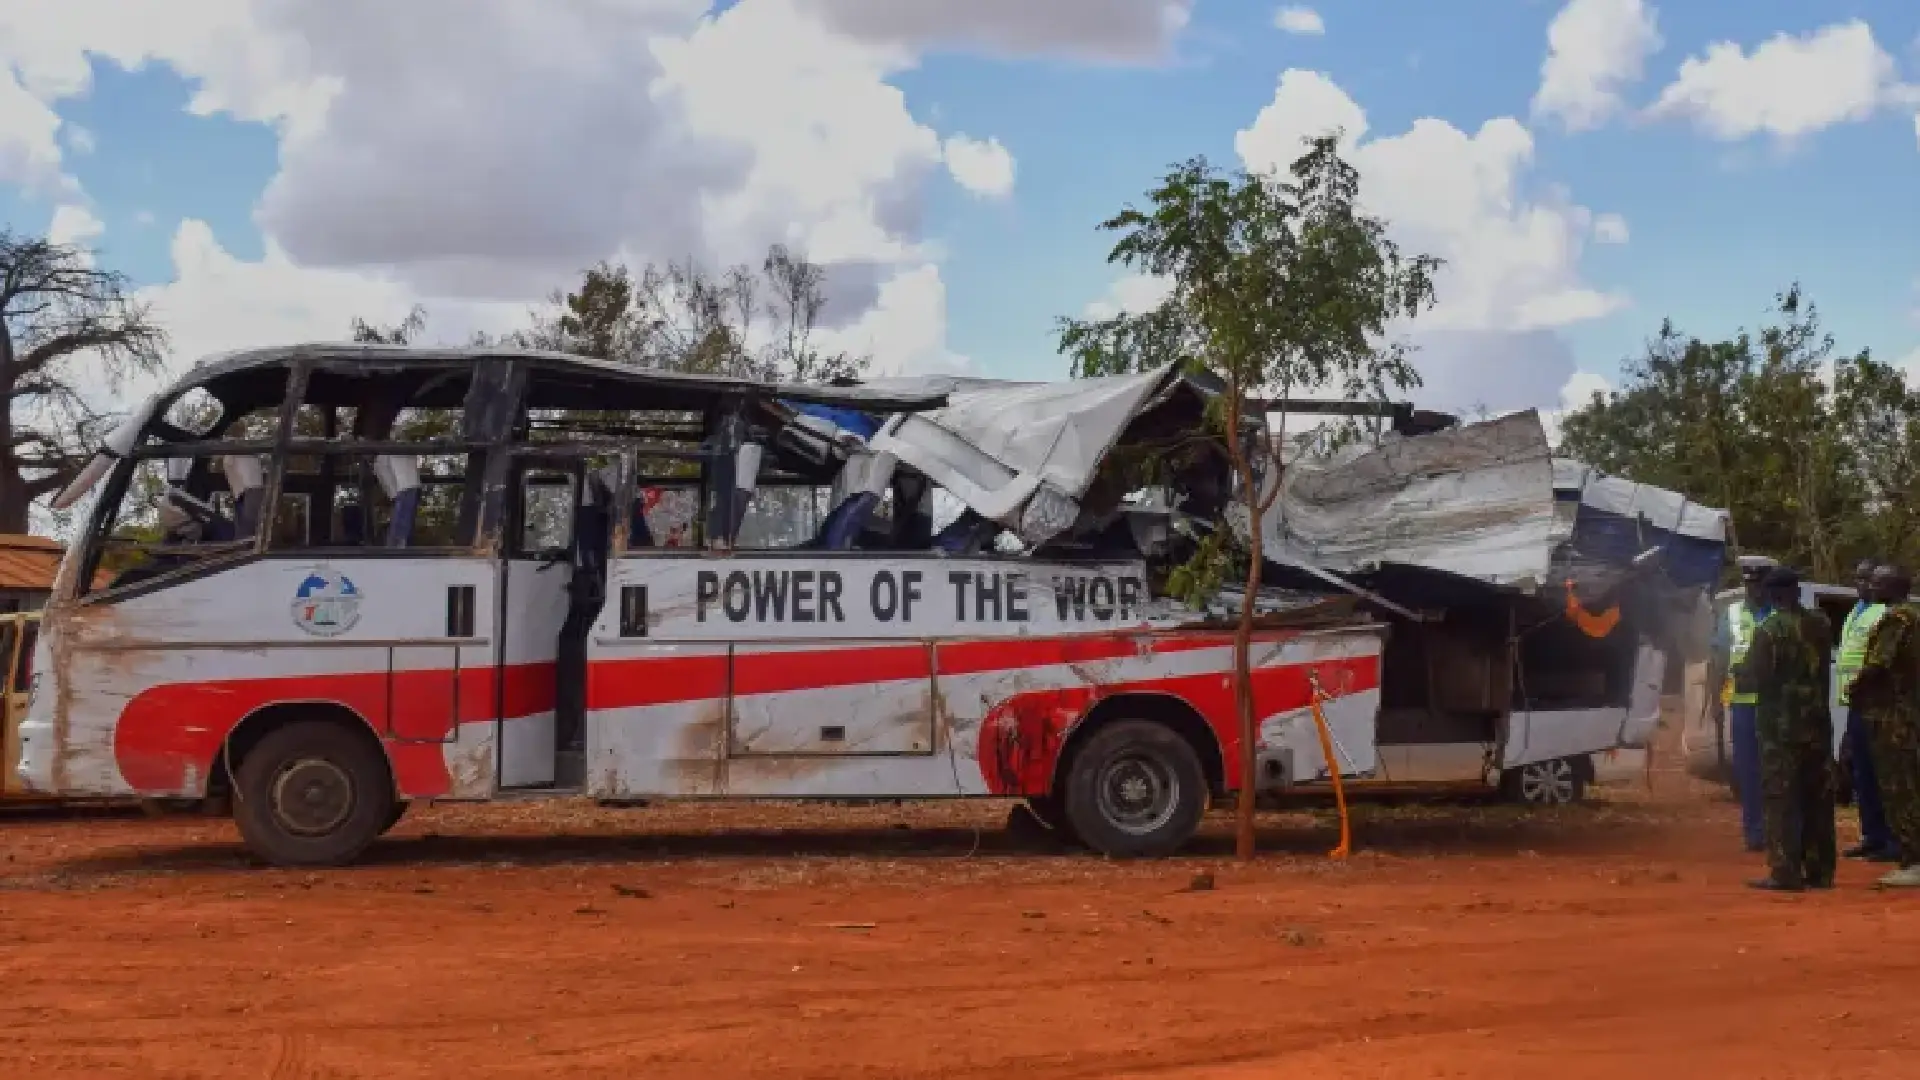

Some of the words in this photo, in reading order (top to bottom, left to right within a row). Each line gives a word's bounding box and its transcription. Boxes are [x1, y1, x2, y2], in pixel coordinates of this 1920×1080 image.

[696, 570, 845, 622] POWER
[869, 569, 922, 622] OF
[948, 570, 1030, 622] THE
